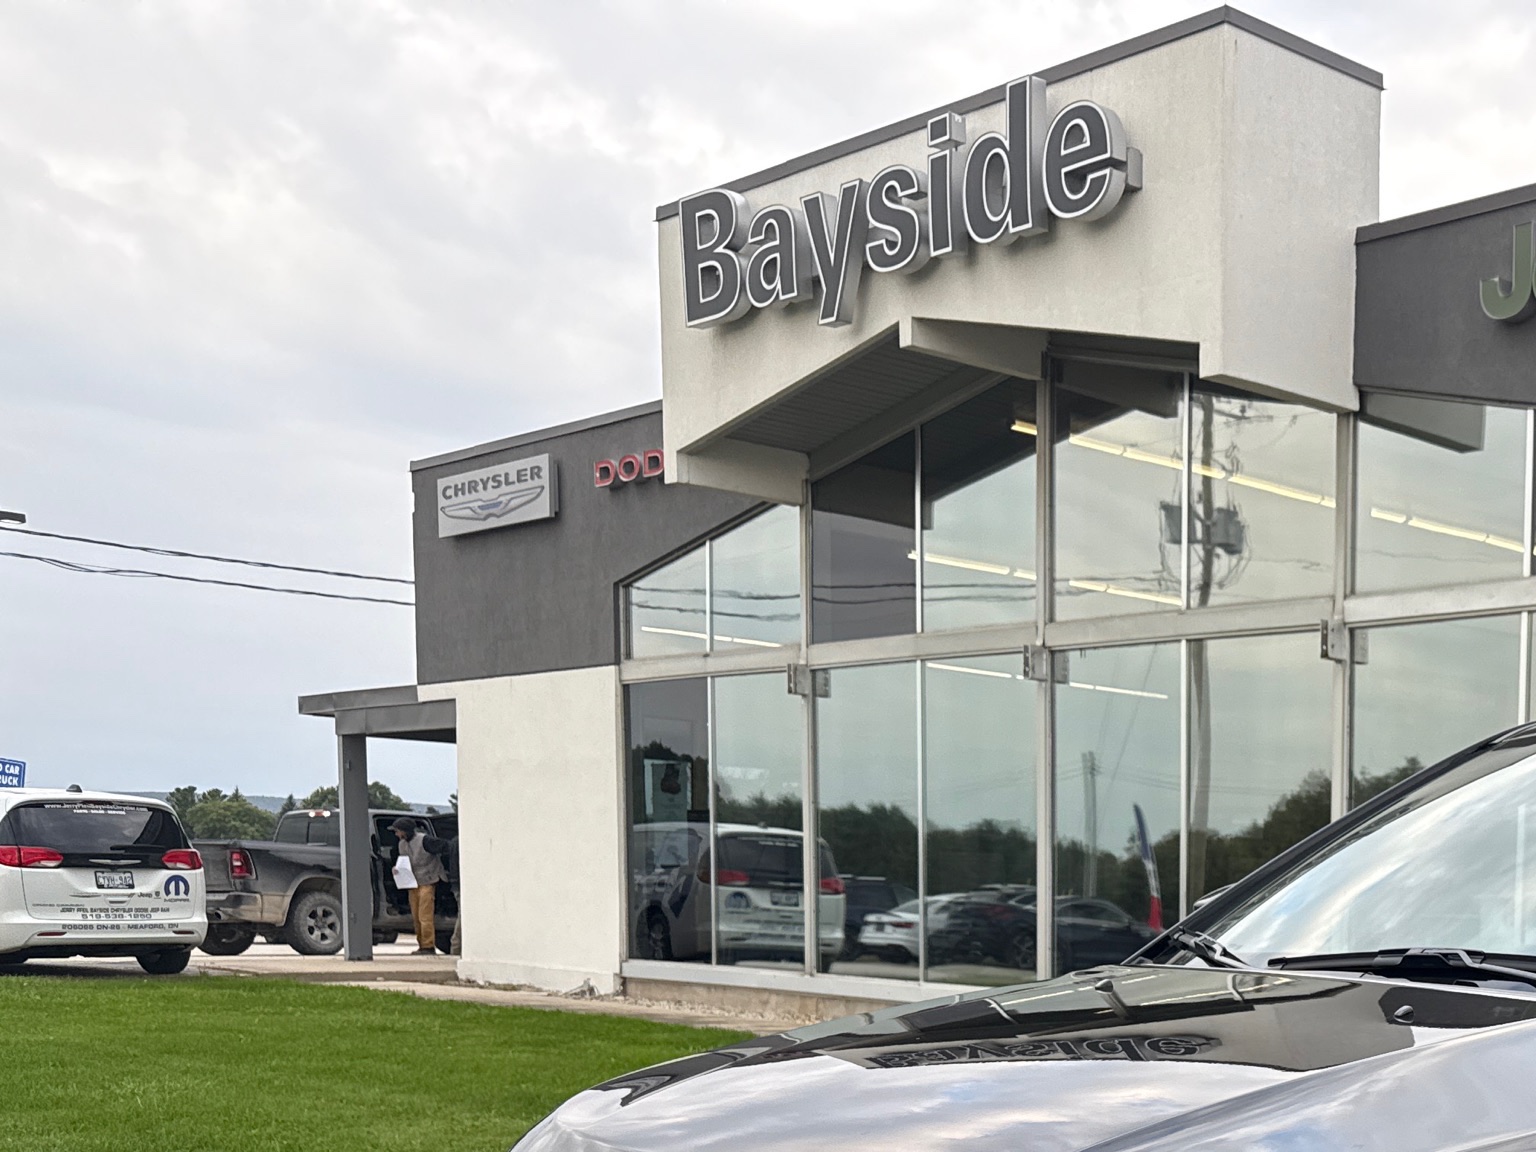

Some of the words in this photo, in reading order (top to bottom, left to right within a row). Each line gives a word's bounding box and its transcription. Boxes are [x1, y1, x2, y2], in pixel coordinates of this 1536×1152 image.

[679, 75, 1128, 329] Bayside
[441, 465, 543, 500] CHRYSLER
[0, 774, 19, 786] UCK
